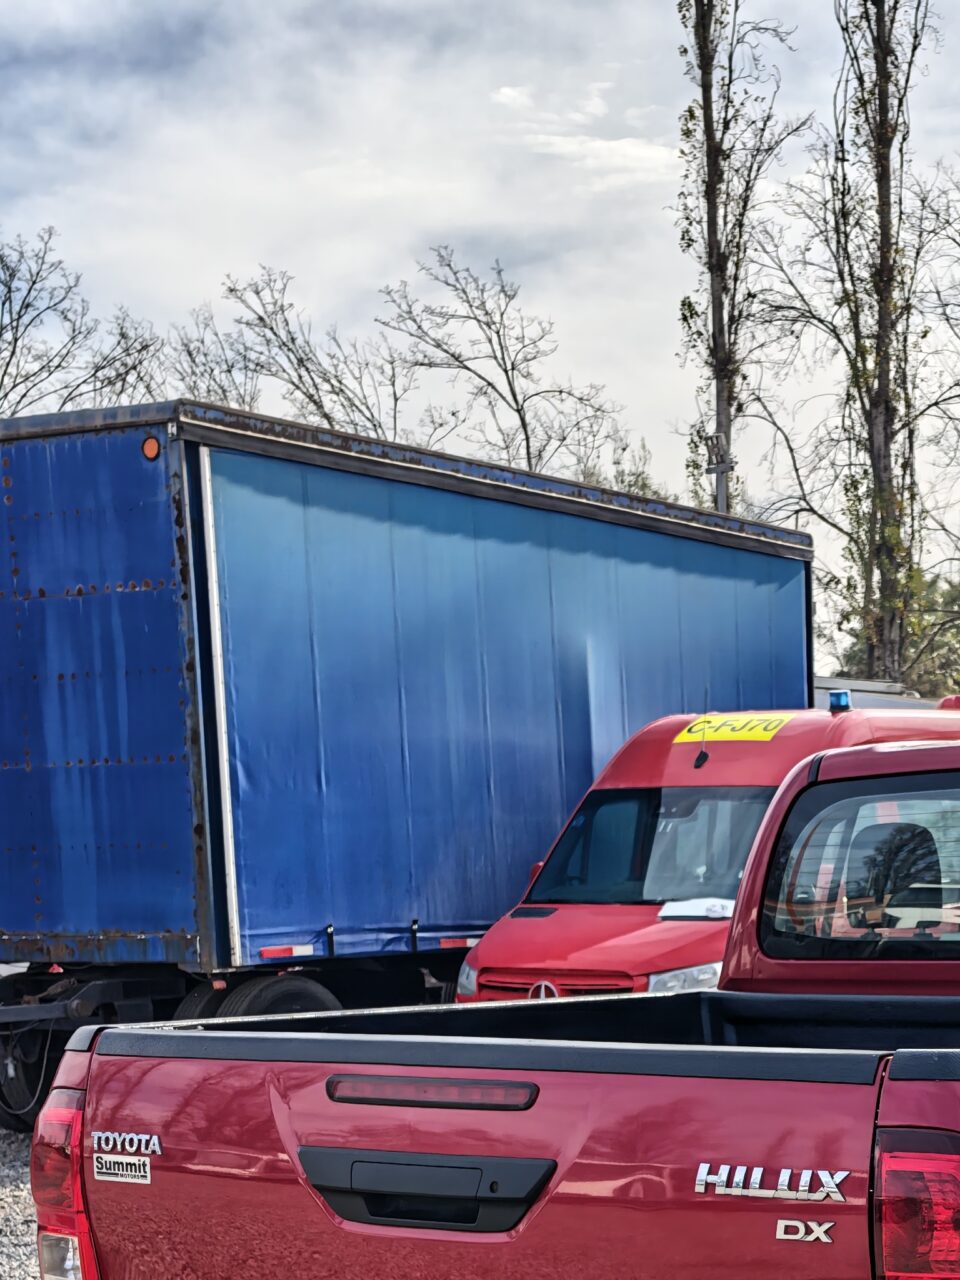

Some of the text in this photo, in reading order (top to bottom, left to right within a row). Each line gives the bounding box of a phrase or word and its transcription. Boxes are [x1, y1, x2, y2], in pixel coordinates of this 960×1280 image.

[687, 718, 785, 735] C-FJ70
[91, 1131, 162, 1154] TOYOTA
[95, 1156, 148, 1174] Summit
[694, 1163, 850, 1202] HILUX
[776, 1219, 835, 1243] DX
